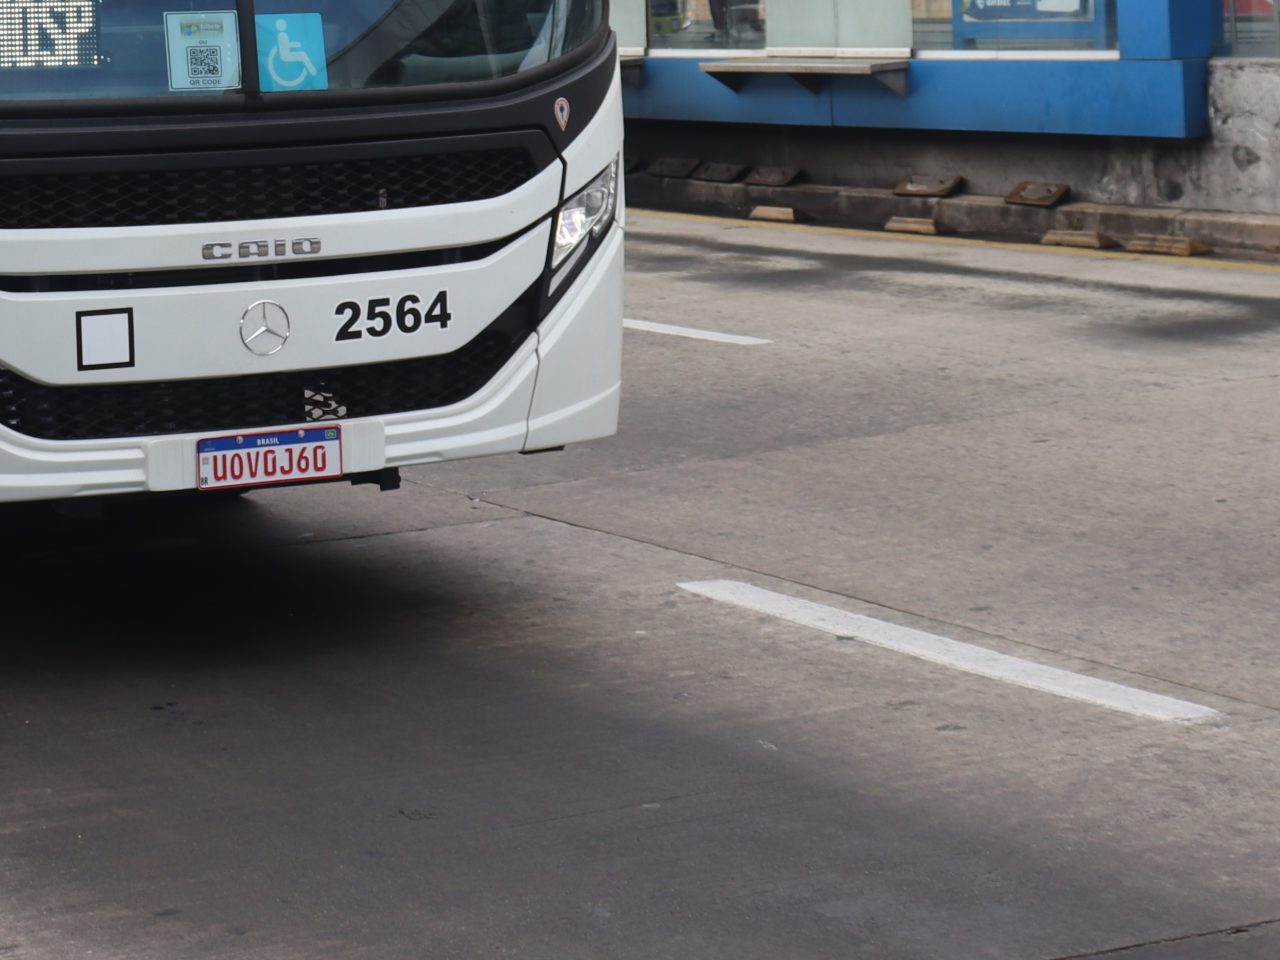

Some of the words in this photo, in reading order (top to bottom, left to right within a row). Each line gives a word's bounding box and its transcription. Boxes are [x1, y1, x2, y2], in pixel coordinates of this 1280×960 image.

[202, 238, 321, 260] CAIO
[334, 290, 451, 342] 2564
[256, 437, 280, 446] BRASIL
[200, 476, 209, 486] BR
